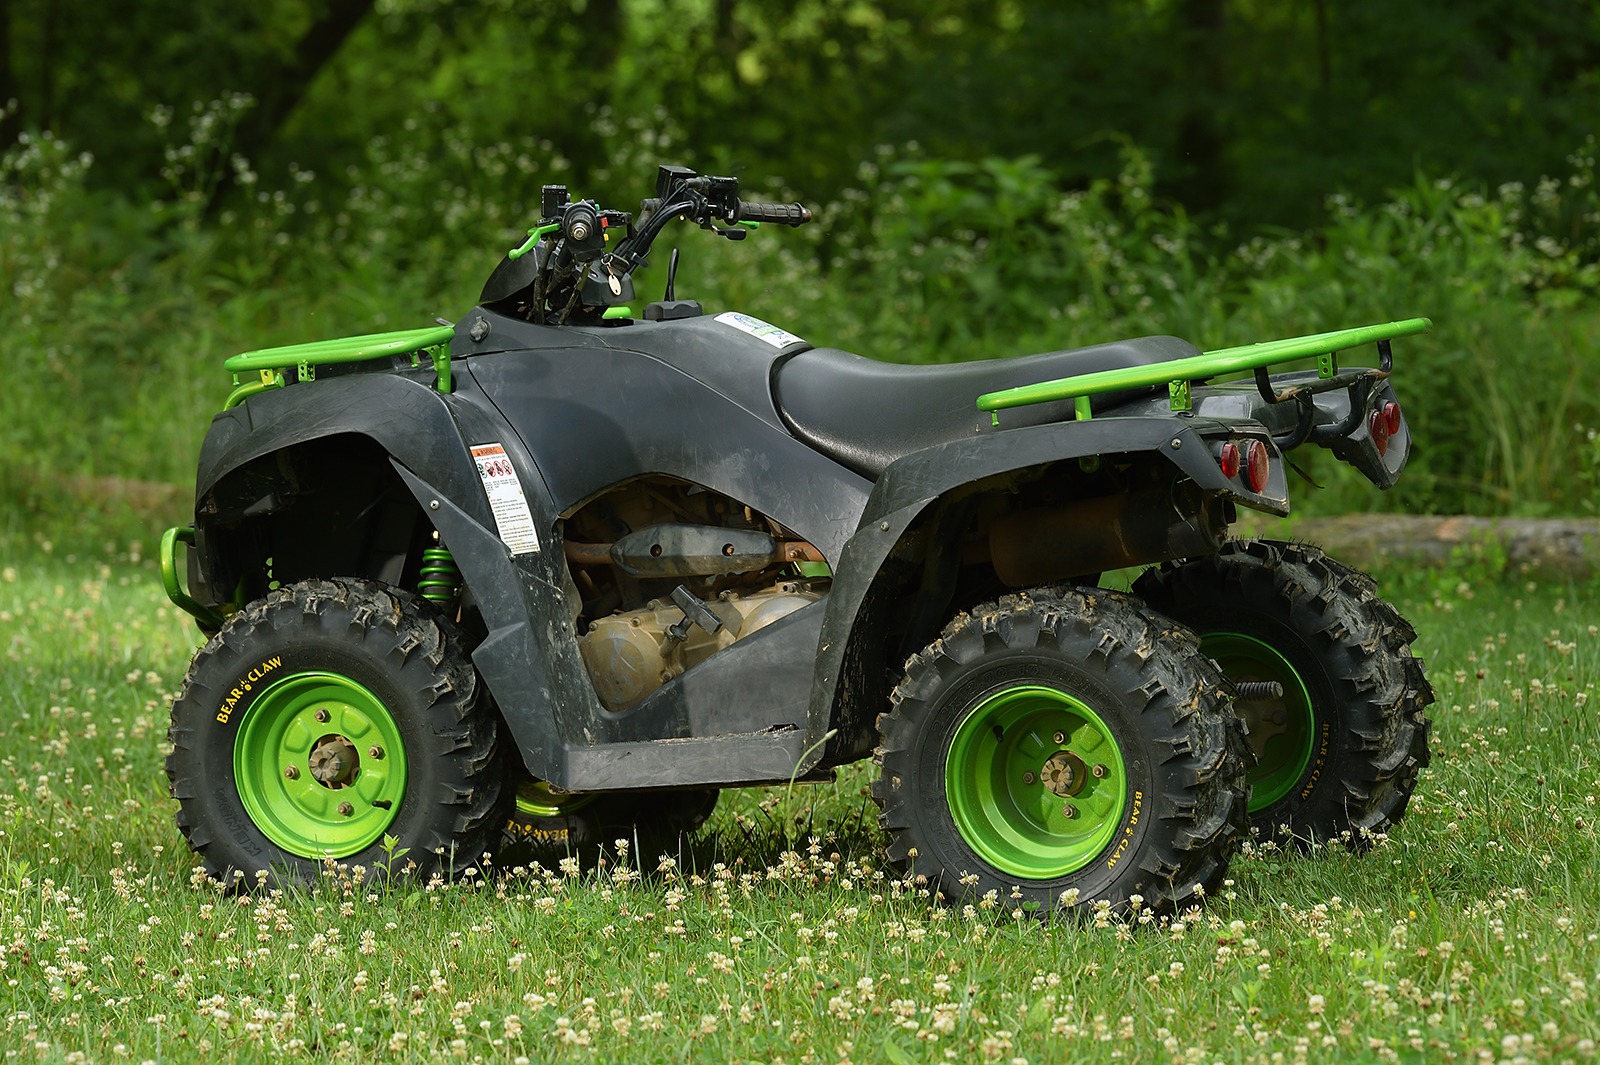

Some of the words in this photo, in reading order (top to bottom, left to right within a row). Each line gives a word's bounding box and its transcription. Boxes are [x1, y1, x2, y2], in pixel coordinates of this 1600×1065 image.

[216, 688, 243, 724] BEAR
[248, 656, 282, 682] CLAW
[1320, 723, 1330, 755] BEAR
[1302, 770, 1320, 800] CLAW
[215, 787, 263, 856] KENDA
[1130, 791, 1143, 825] BEAR
[1107, 839, 1129, 870] CLAW
